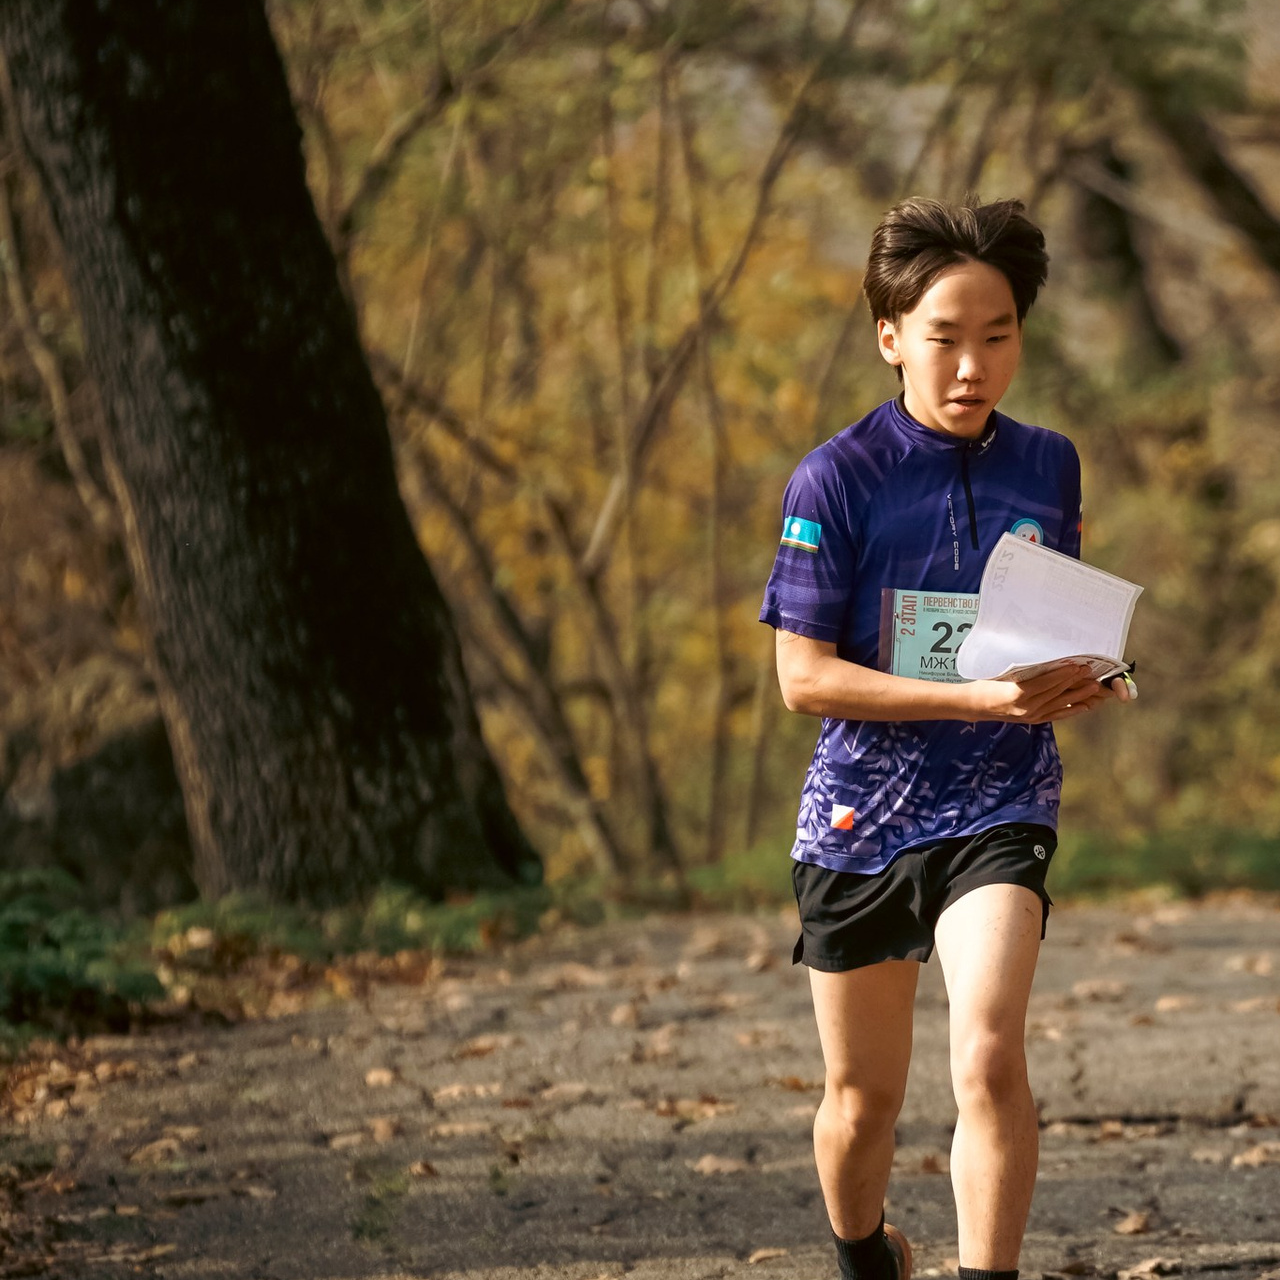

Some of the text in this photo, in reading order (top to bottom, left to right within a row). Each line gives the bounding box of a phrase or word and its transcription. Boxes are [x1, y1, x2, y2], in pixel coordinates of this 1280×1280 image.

[946, 493, 958, 537] VICTORY
[900, 595, 917, 636] 2 ЭТАП
[923, 596, 973, 608] ПЕРВЕНСТВО
